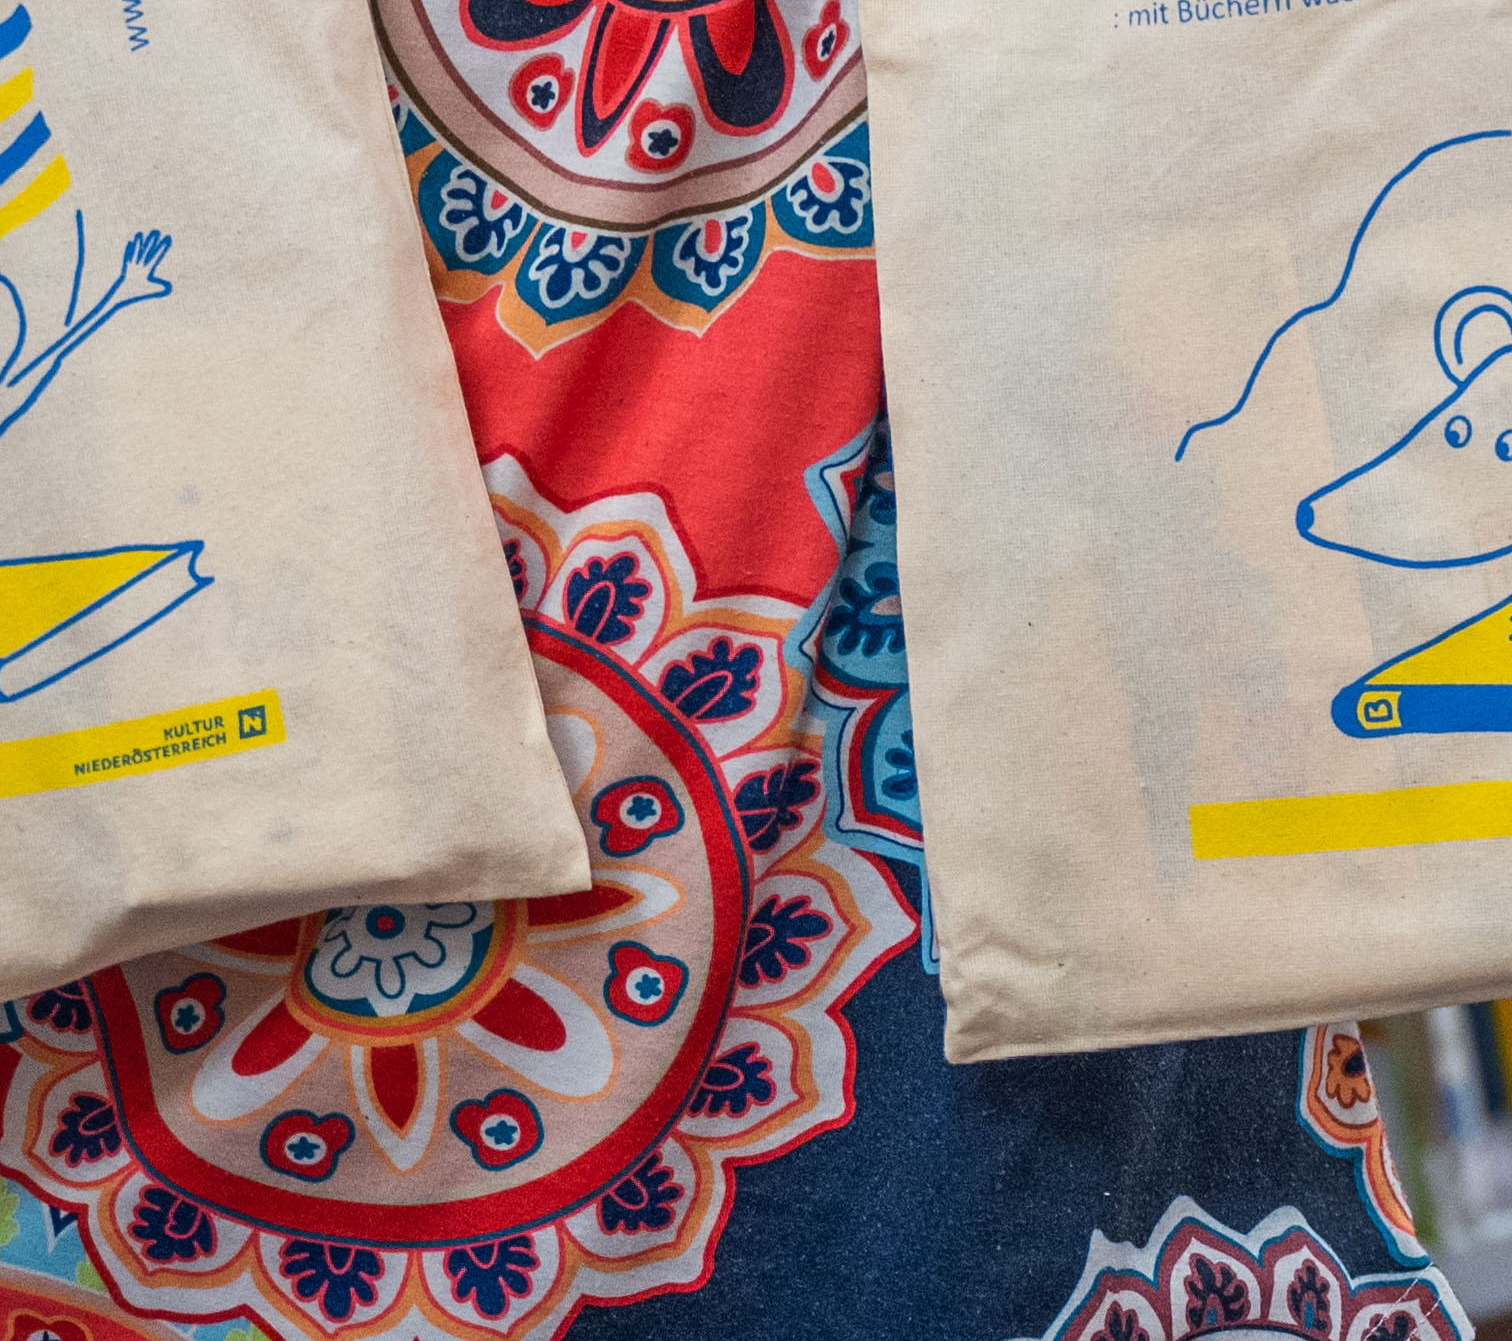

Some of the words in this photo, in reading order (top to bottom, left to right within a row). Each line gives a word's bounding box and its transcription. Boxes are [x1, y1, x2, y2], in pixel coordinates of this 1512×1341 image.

[1128, 1, 1169, 27] mit
[162, 715, 226, 741] KULTUR
[73, 732, 228, 777] NIEDERÖSTERREICH
